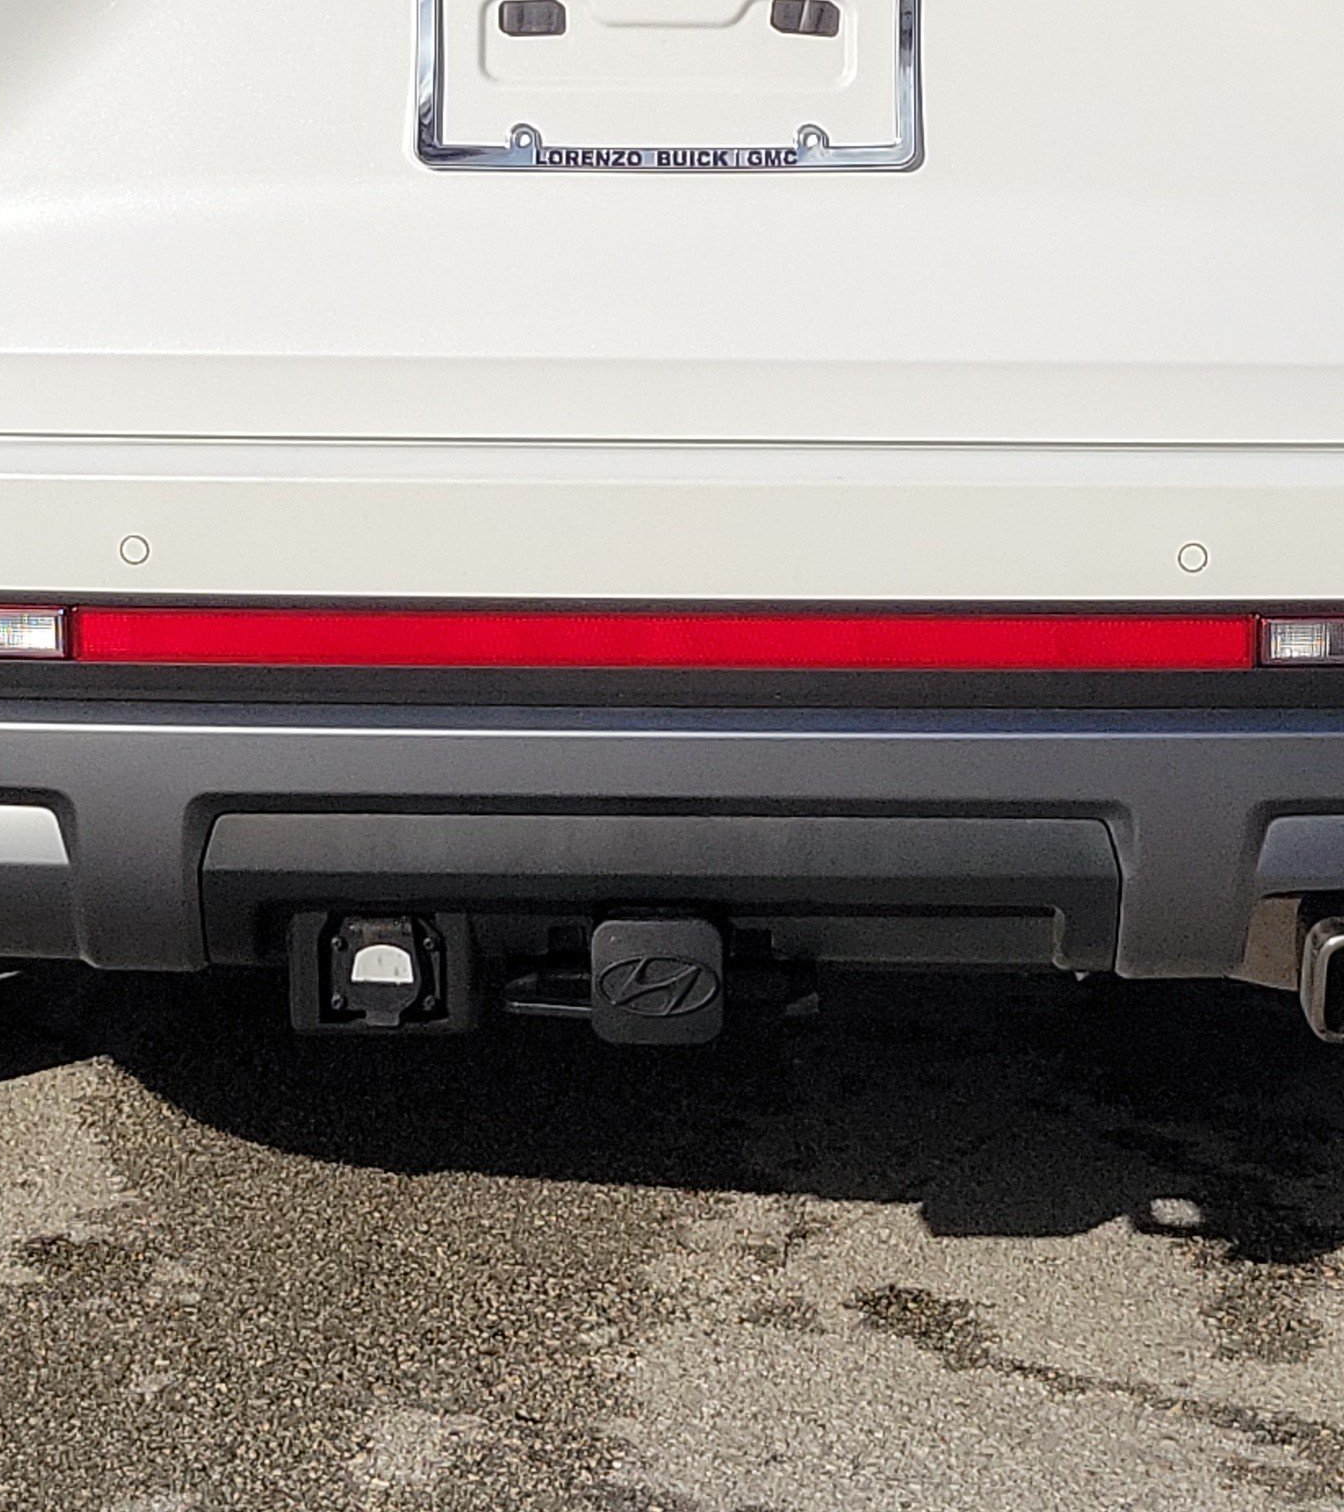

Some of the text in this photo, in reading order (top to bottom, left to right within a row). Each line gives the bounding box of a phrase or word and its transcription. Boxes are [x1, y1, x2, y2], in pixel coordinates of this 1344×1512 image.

[536, 149, 798, 167] LORENZO BUICK GMC
